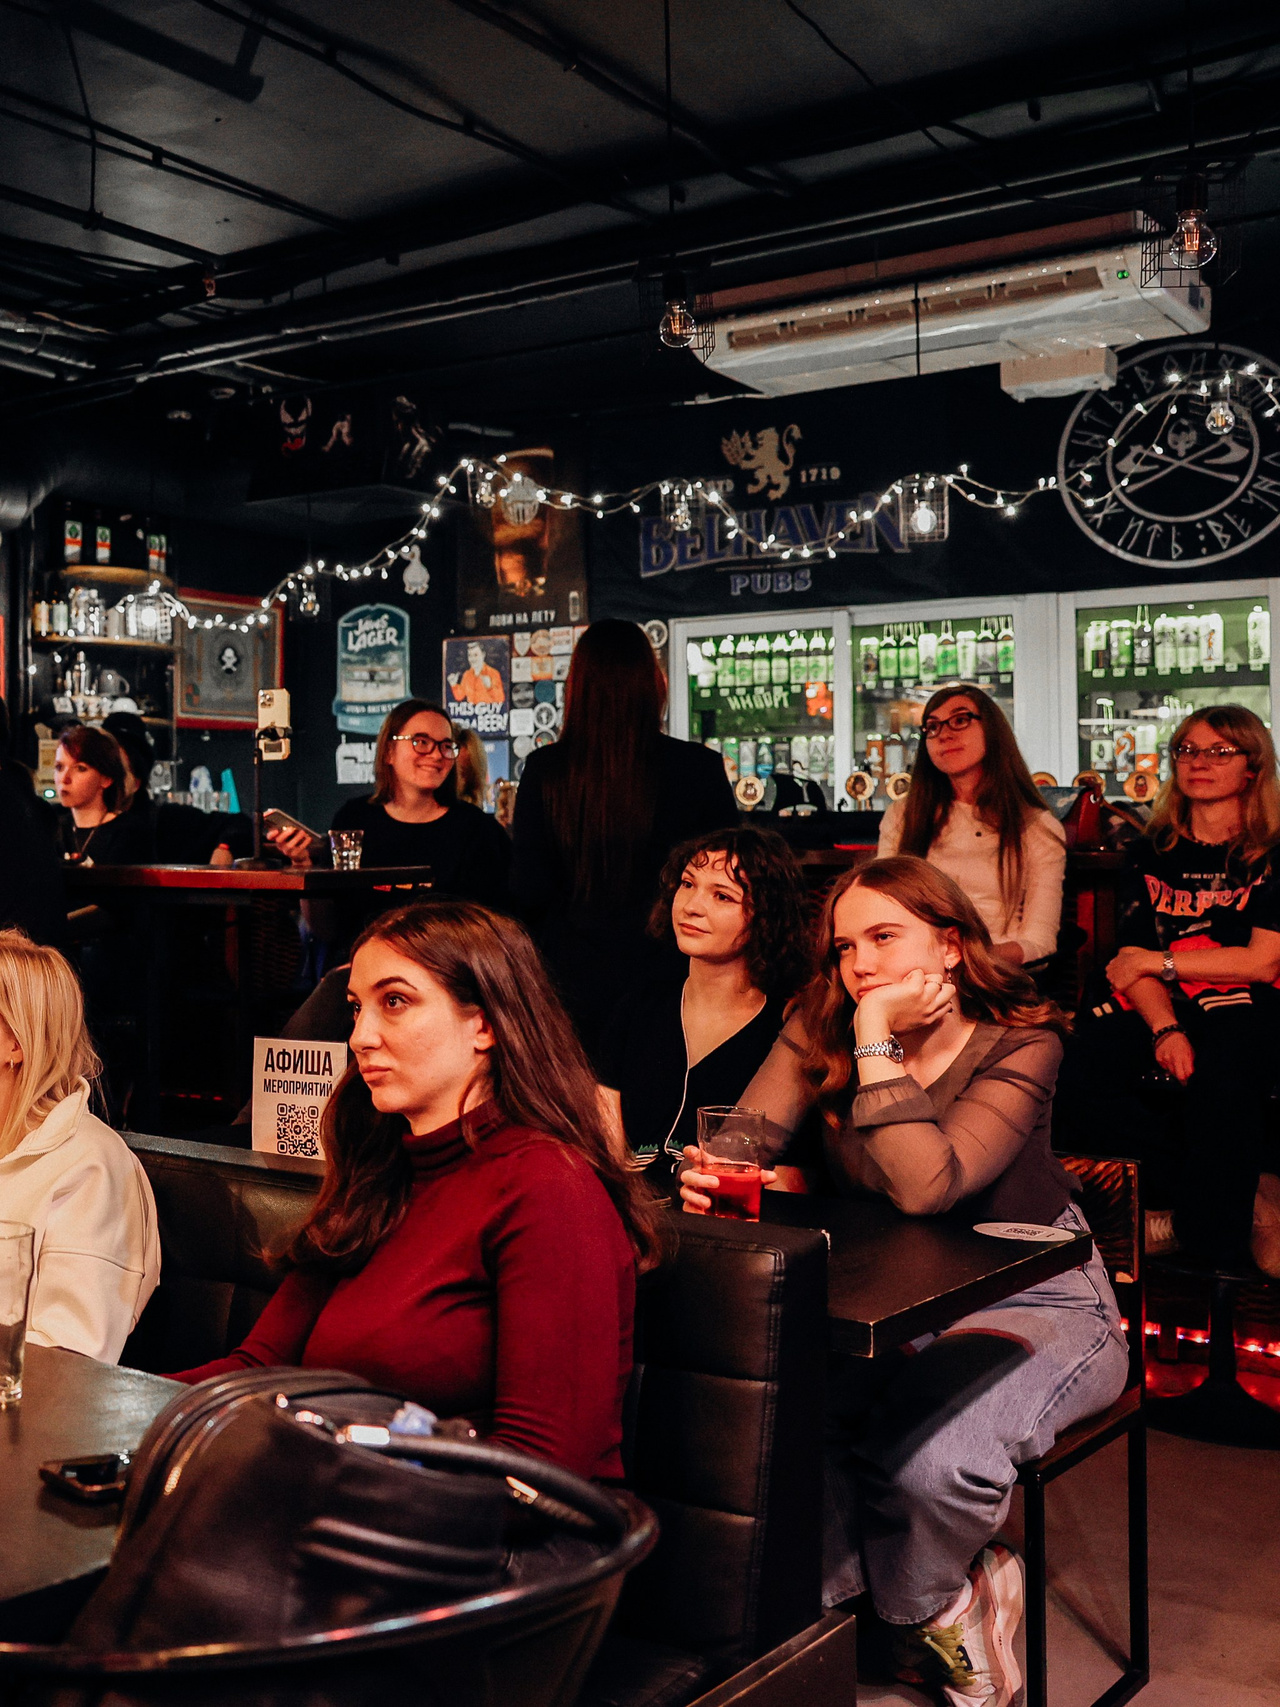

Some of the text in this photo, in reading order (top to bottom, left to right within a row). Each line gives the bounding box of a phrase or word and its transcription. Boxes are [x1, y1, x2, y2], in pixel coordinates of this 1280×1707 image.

[730, 569, 812, 596] PUBS
[515, 612, 529, 624] НА
[347, 626, 399, 652] LAGER
[448, 701, 503, 716] THIS GUY
[477, 713, 509, 733] BEER!
[264, 1047, 333, 1076] АФИША
[263, 1078, 333, 1098] МЕРОПРИЯТИЙ
